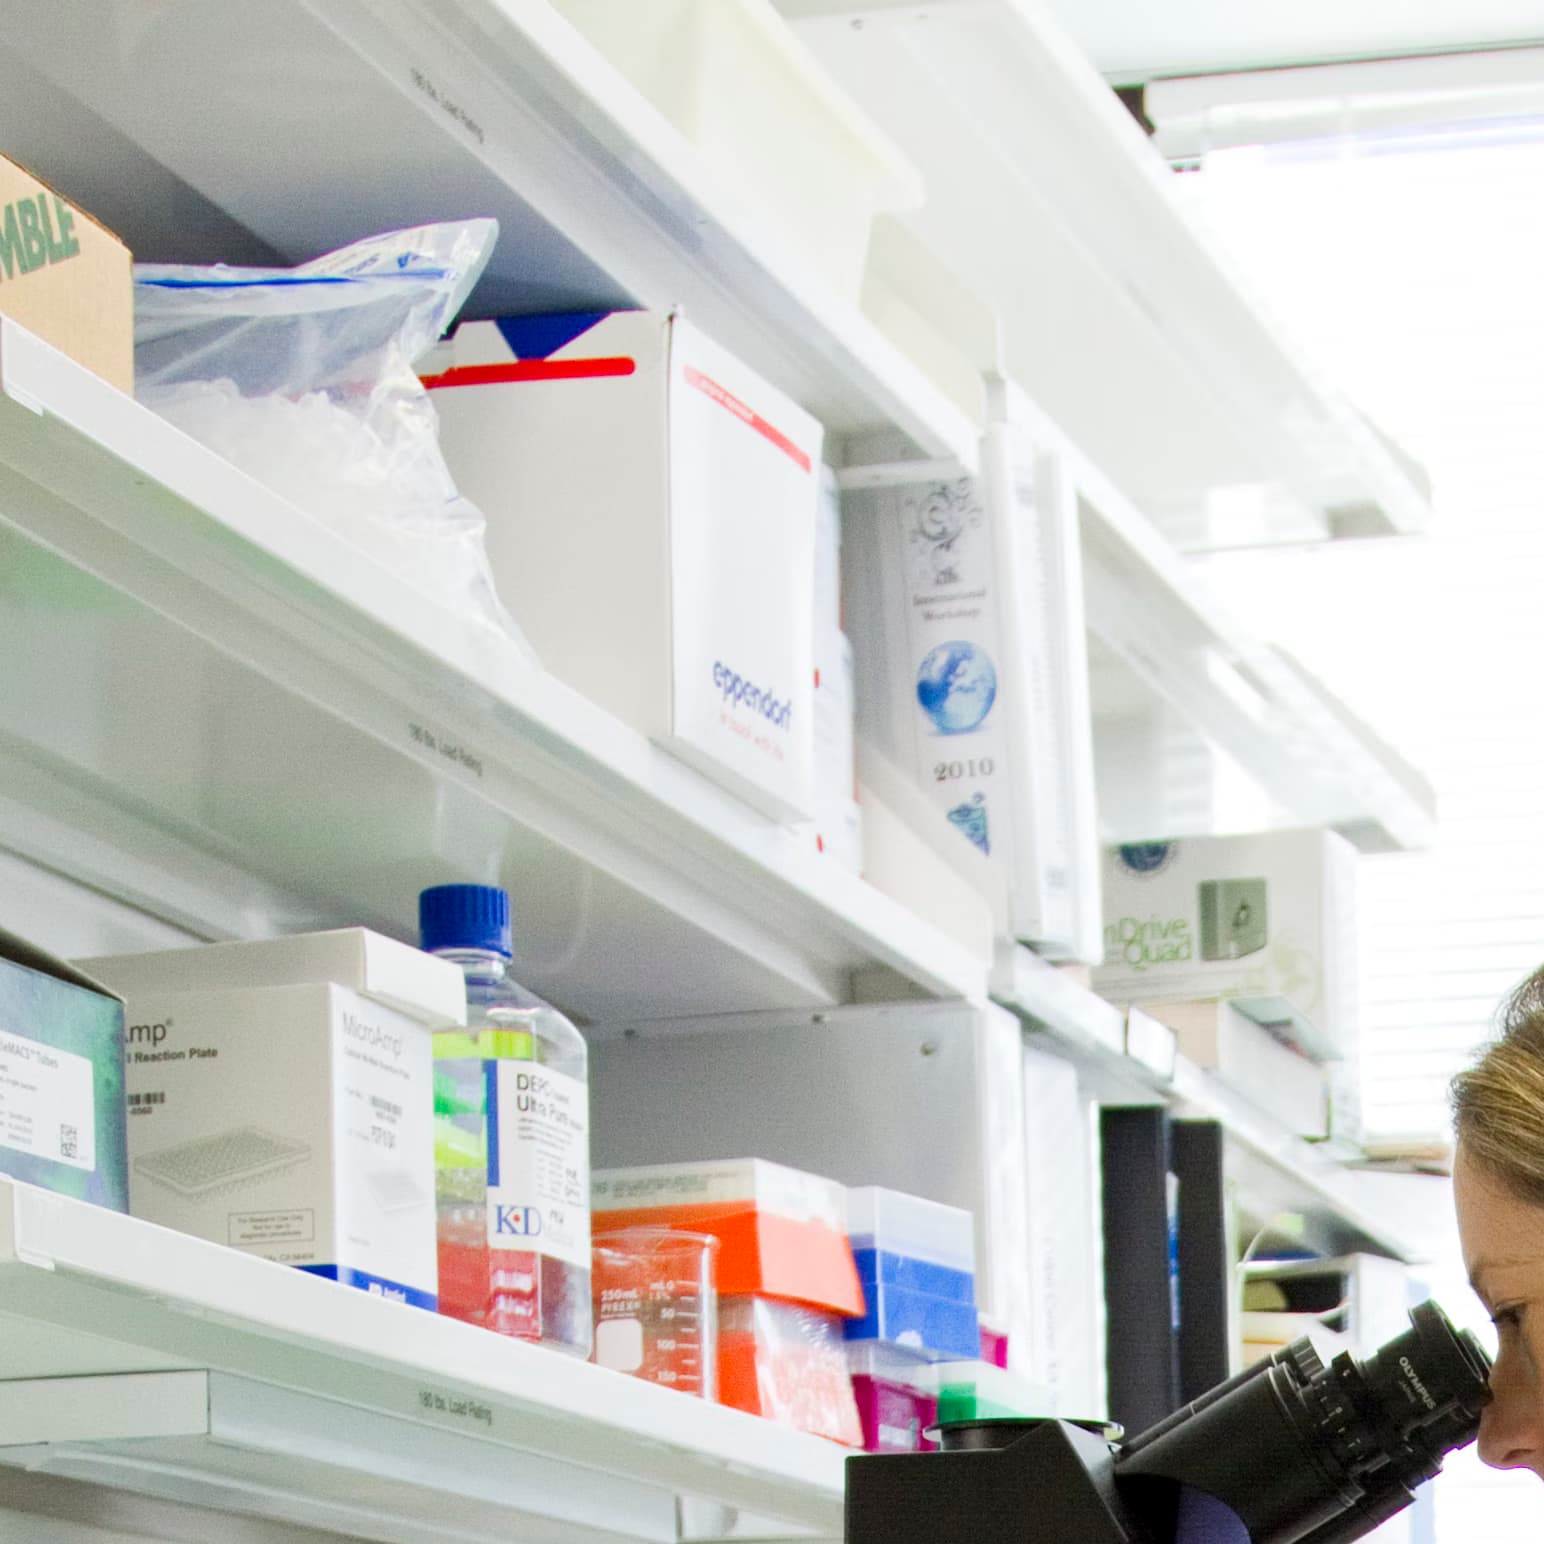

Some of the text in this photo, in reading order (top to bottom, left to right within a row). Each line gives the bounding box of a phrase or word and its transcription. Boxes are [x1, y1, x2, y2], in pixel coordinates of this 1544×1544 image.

[712, 660, 792, 733] eppendorf
[933, 757, 995, 781] 2010
[1122, 932, 1193, 972] Quad
[134, 1051, 186, 1065] Reaction
[189, 1046, 218, 1060] Plate
[660, 1306, 676, 1319] 50
[656, 1339, 676, 1351] 100
[1399, 1356, 1437, 1410] OLYMPUS
